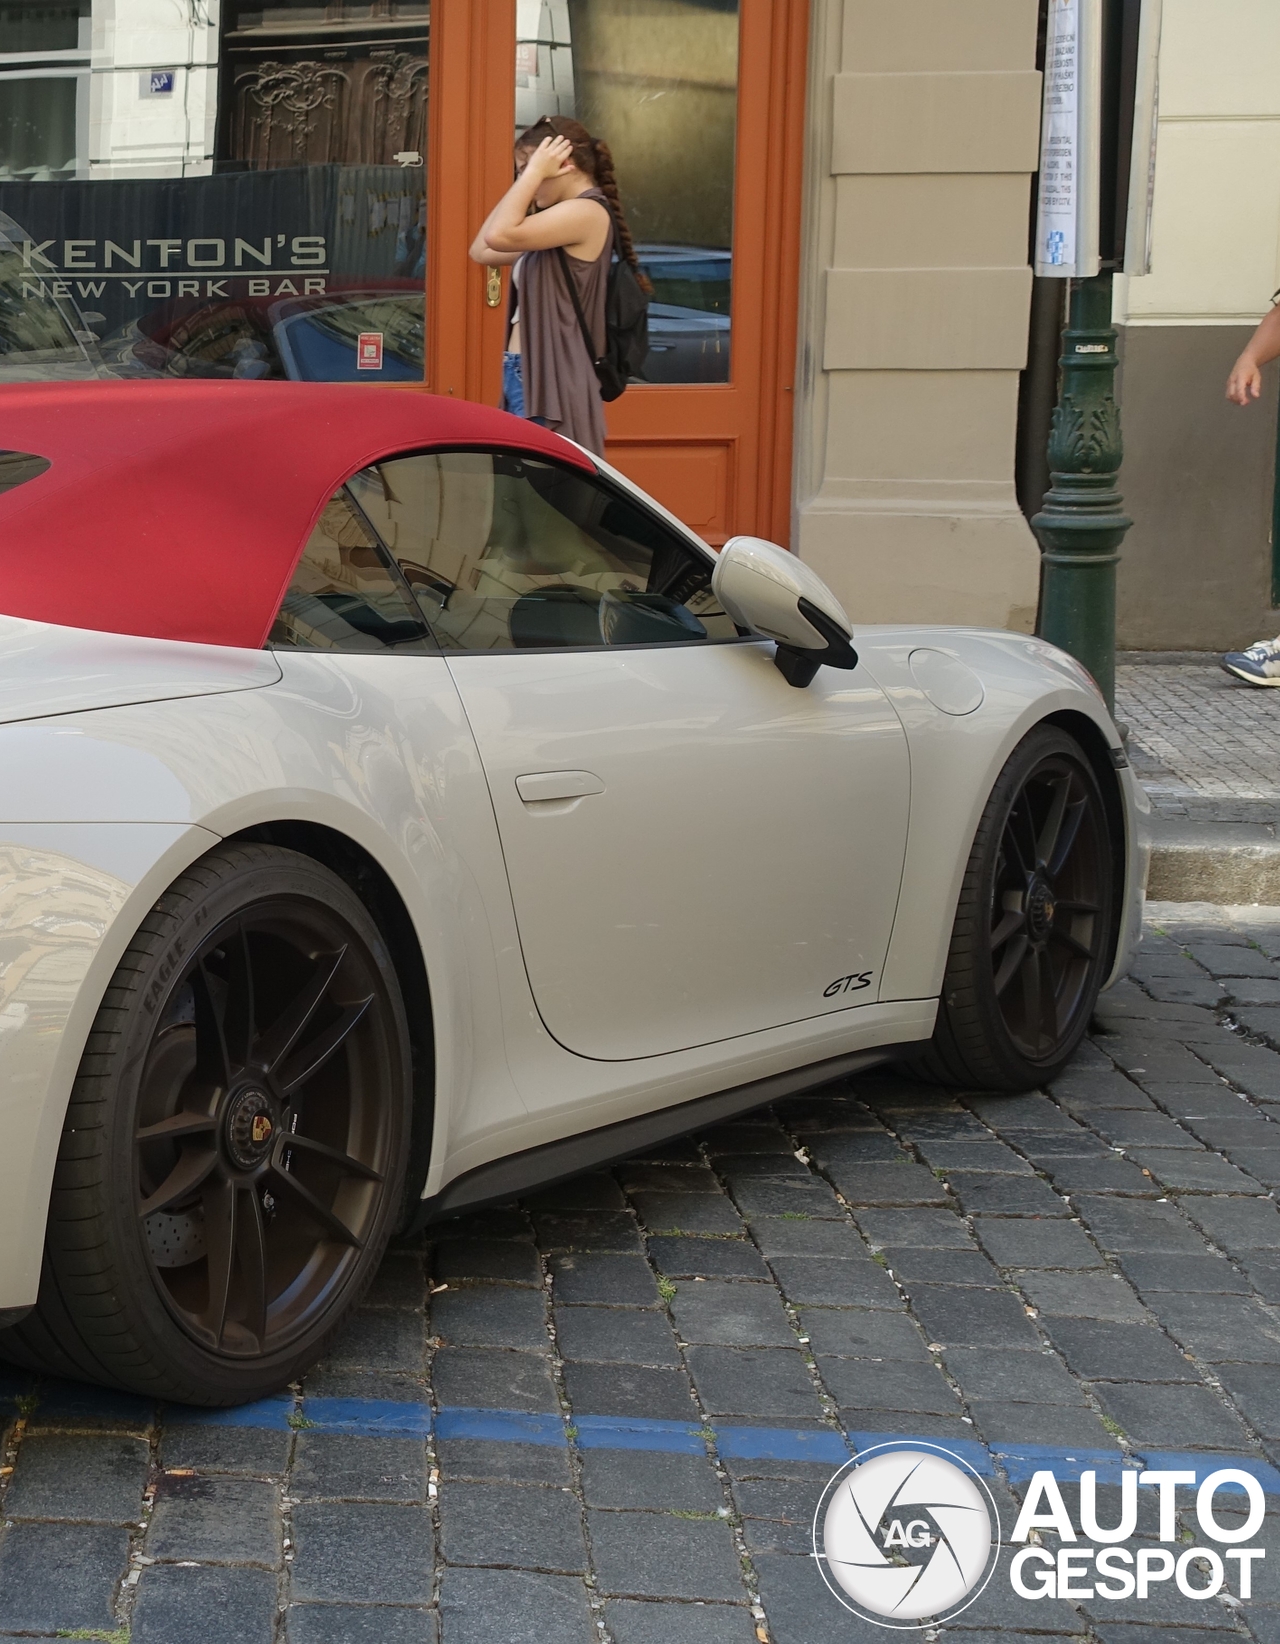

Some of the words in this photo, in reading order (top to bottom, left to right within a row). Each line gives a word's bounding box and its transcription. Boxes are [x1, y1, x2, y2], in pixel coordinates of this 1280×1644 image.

[22, 234, 326, 269] KENTON'S
[22, 280, 108, 299] NEW
[122, 280, 230, 298] YORK
[248, 278, 326, 297] BAR
[143, 936, 186, 1016] EAGLE
[823, 971, 873, 998] GTS
